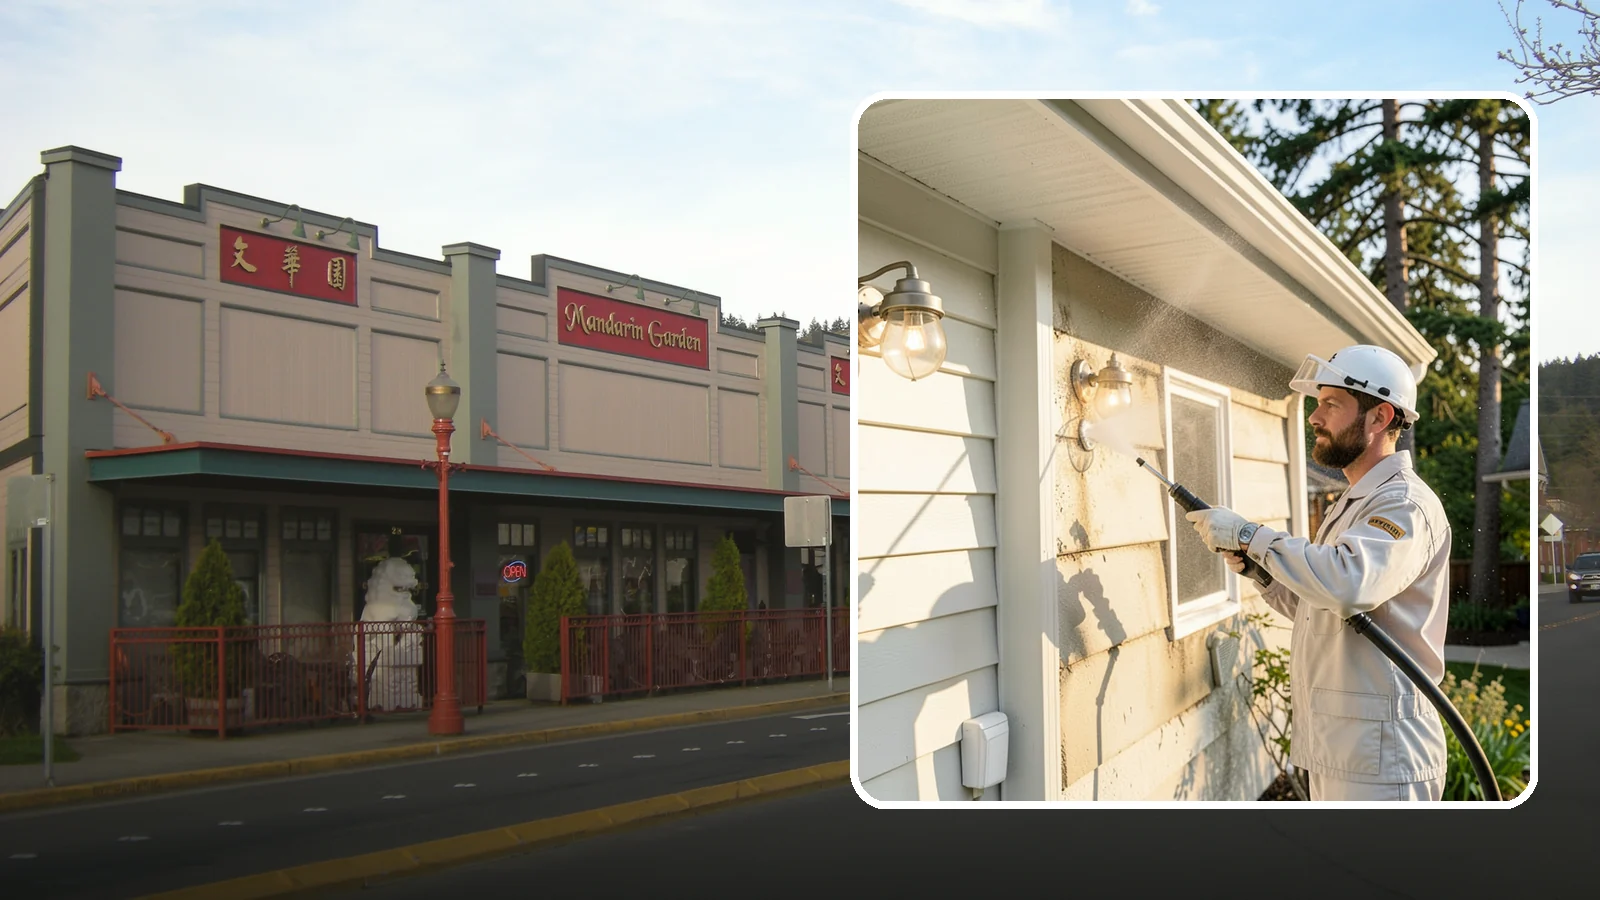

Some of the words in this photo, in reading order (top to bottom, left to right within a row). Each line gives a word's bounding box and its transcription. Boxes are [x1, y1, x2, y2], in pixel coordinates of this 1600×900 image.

[231, 236, 346, 291] 文華園
[564, 302, 644, 341] Mandarin
[648, 320, 701, 352] Garden
[503, 565, 527, 578] OPEN
